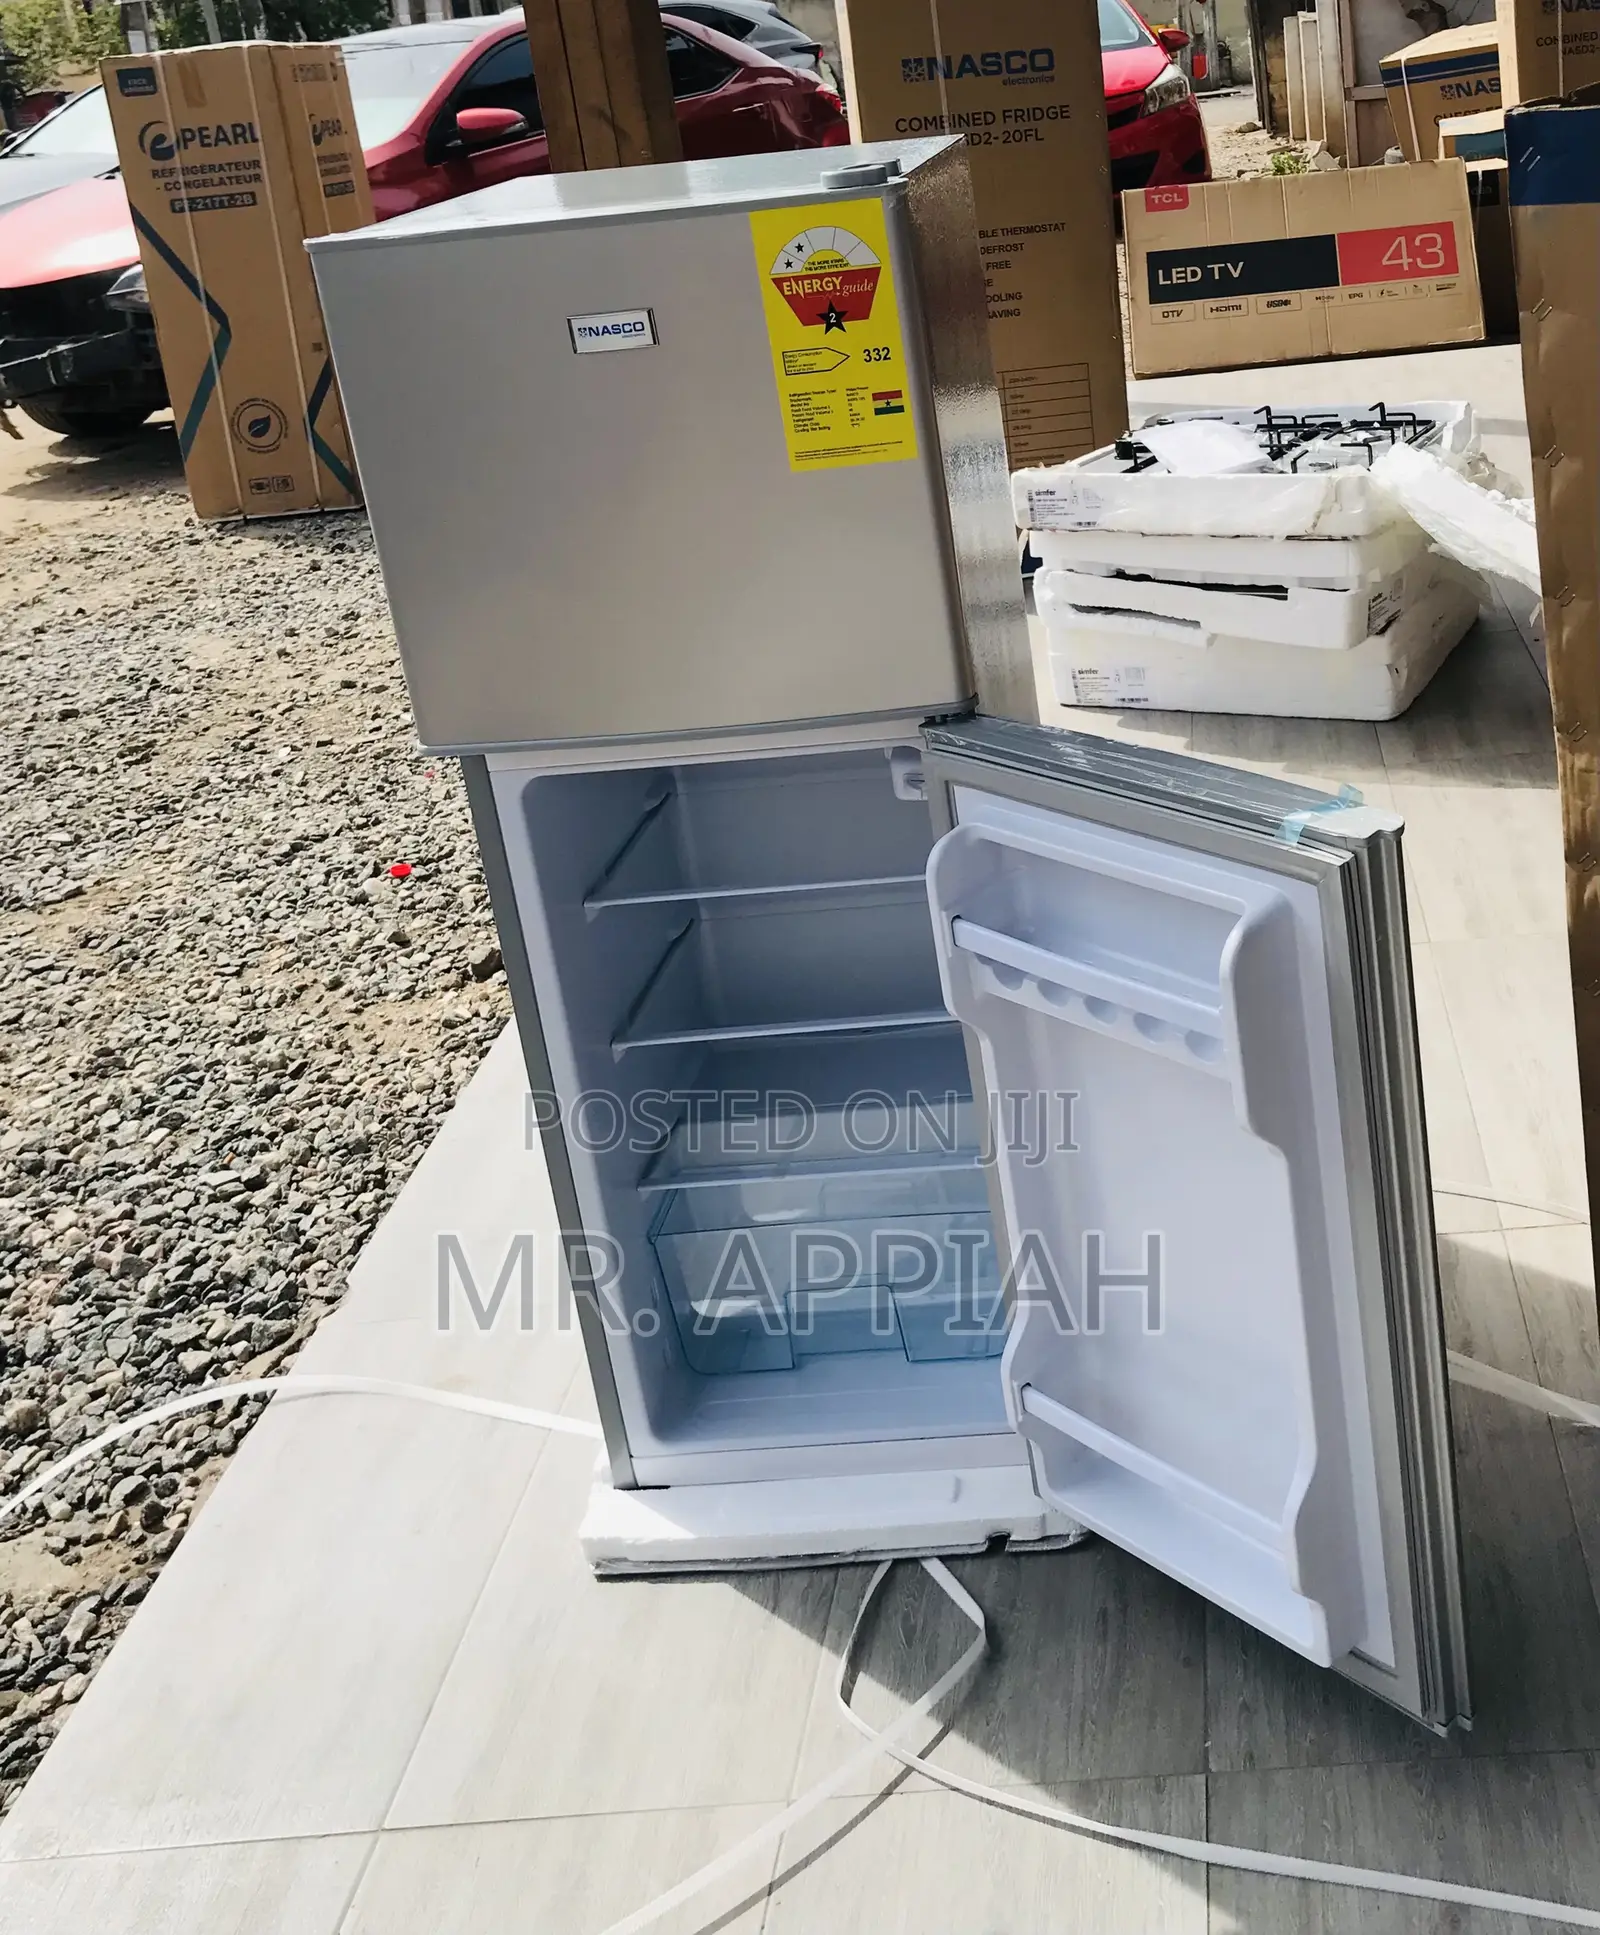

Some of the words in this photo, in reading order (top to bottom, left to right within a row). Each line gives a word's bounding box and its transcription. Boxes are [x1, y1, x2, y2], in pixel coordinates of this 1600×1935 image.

[926, 48, 1055, 81] NASCO
[1002, 74, 1055, 86] electronics
[895, 111, 996, 133] COMBINED
[1003, 105, 1071, 124] FRIDGE
[180, 121, 260, 150] PEARL
[1151, 192, 1183, 204] TCL
[1000, 222, 1066, 236] THERMOSTAT
[980, 242, 1024, 255] DEFROST
[1381, 233, 1445, 271] 43
[986, 260, 1011, 271] FREE
[1158, 266, 1202, 286] LED
[1207, 261, 1244, 280] TV
[782, 276, 843, 299] ENERGY
[842, 279, 874, 297] guide
[1348, 292, 1364, 300] EPG
[829, 312, 837, 323] 2
[588, 321, 645, 337] NASCO
[863, 346, 891, 363] 332
